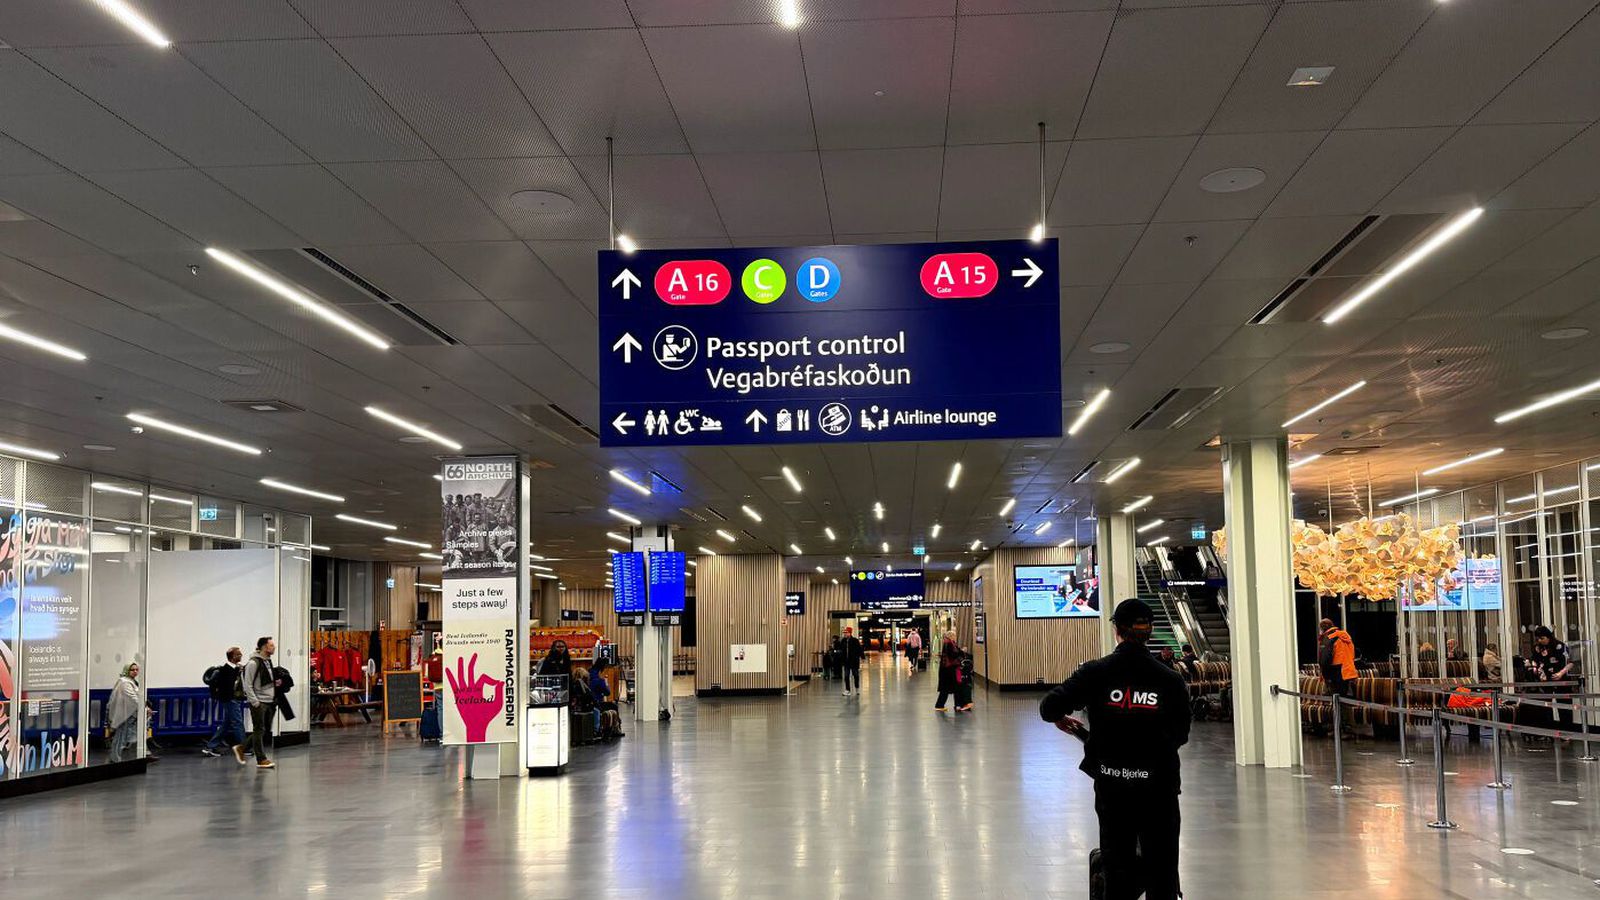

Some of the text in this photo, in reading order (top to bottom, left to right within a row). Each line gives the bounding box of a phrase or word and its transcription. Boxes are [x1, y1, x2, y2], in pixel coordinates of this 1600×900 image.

[668, 268, 719, 292] A 16
[754, 265, 773, 290] C
[809, 264, 831, 289] D
[933, 260, 986, 285] A 15
[706, 331, 905, 362] Passport control
[706, 362, 911, 394] Vegabréfaskoðun
[685, 409, 699, 417] WC
[778, 413, 792, 430] shop
[893, 409, 997, 426] Airline lounge
[446, 463, 512, 479] 66 NORTH
[446, 541, 479, 550] Samples
[456, 588, 476, 597] Just
[487, 587, 503, 597] few
[452, 599, 507, 609] steps away!
[454, 695, 494, 704] Iceland
